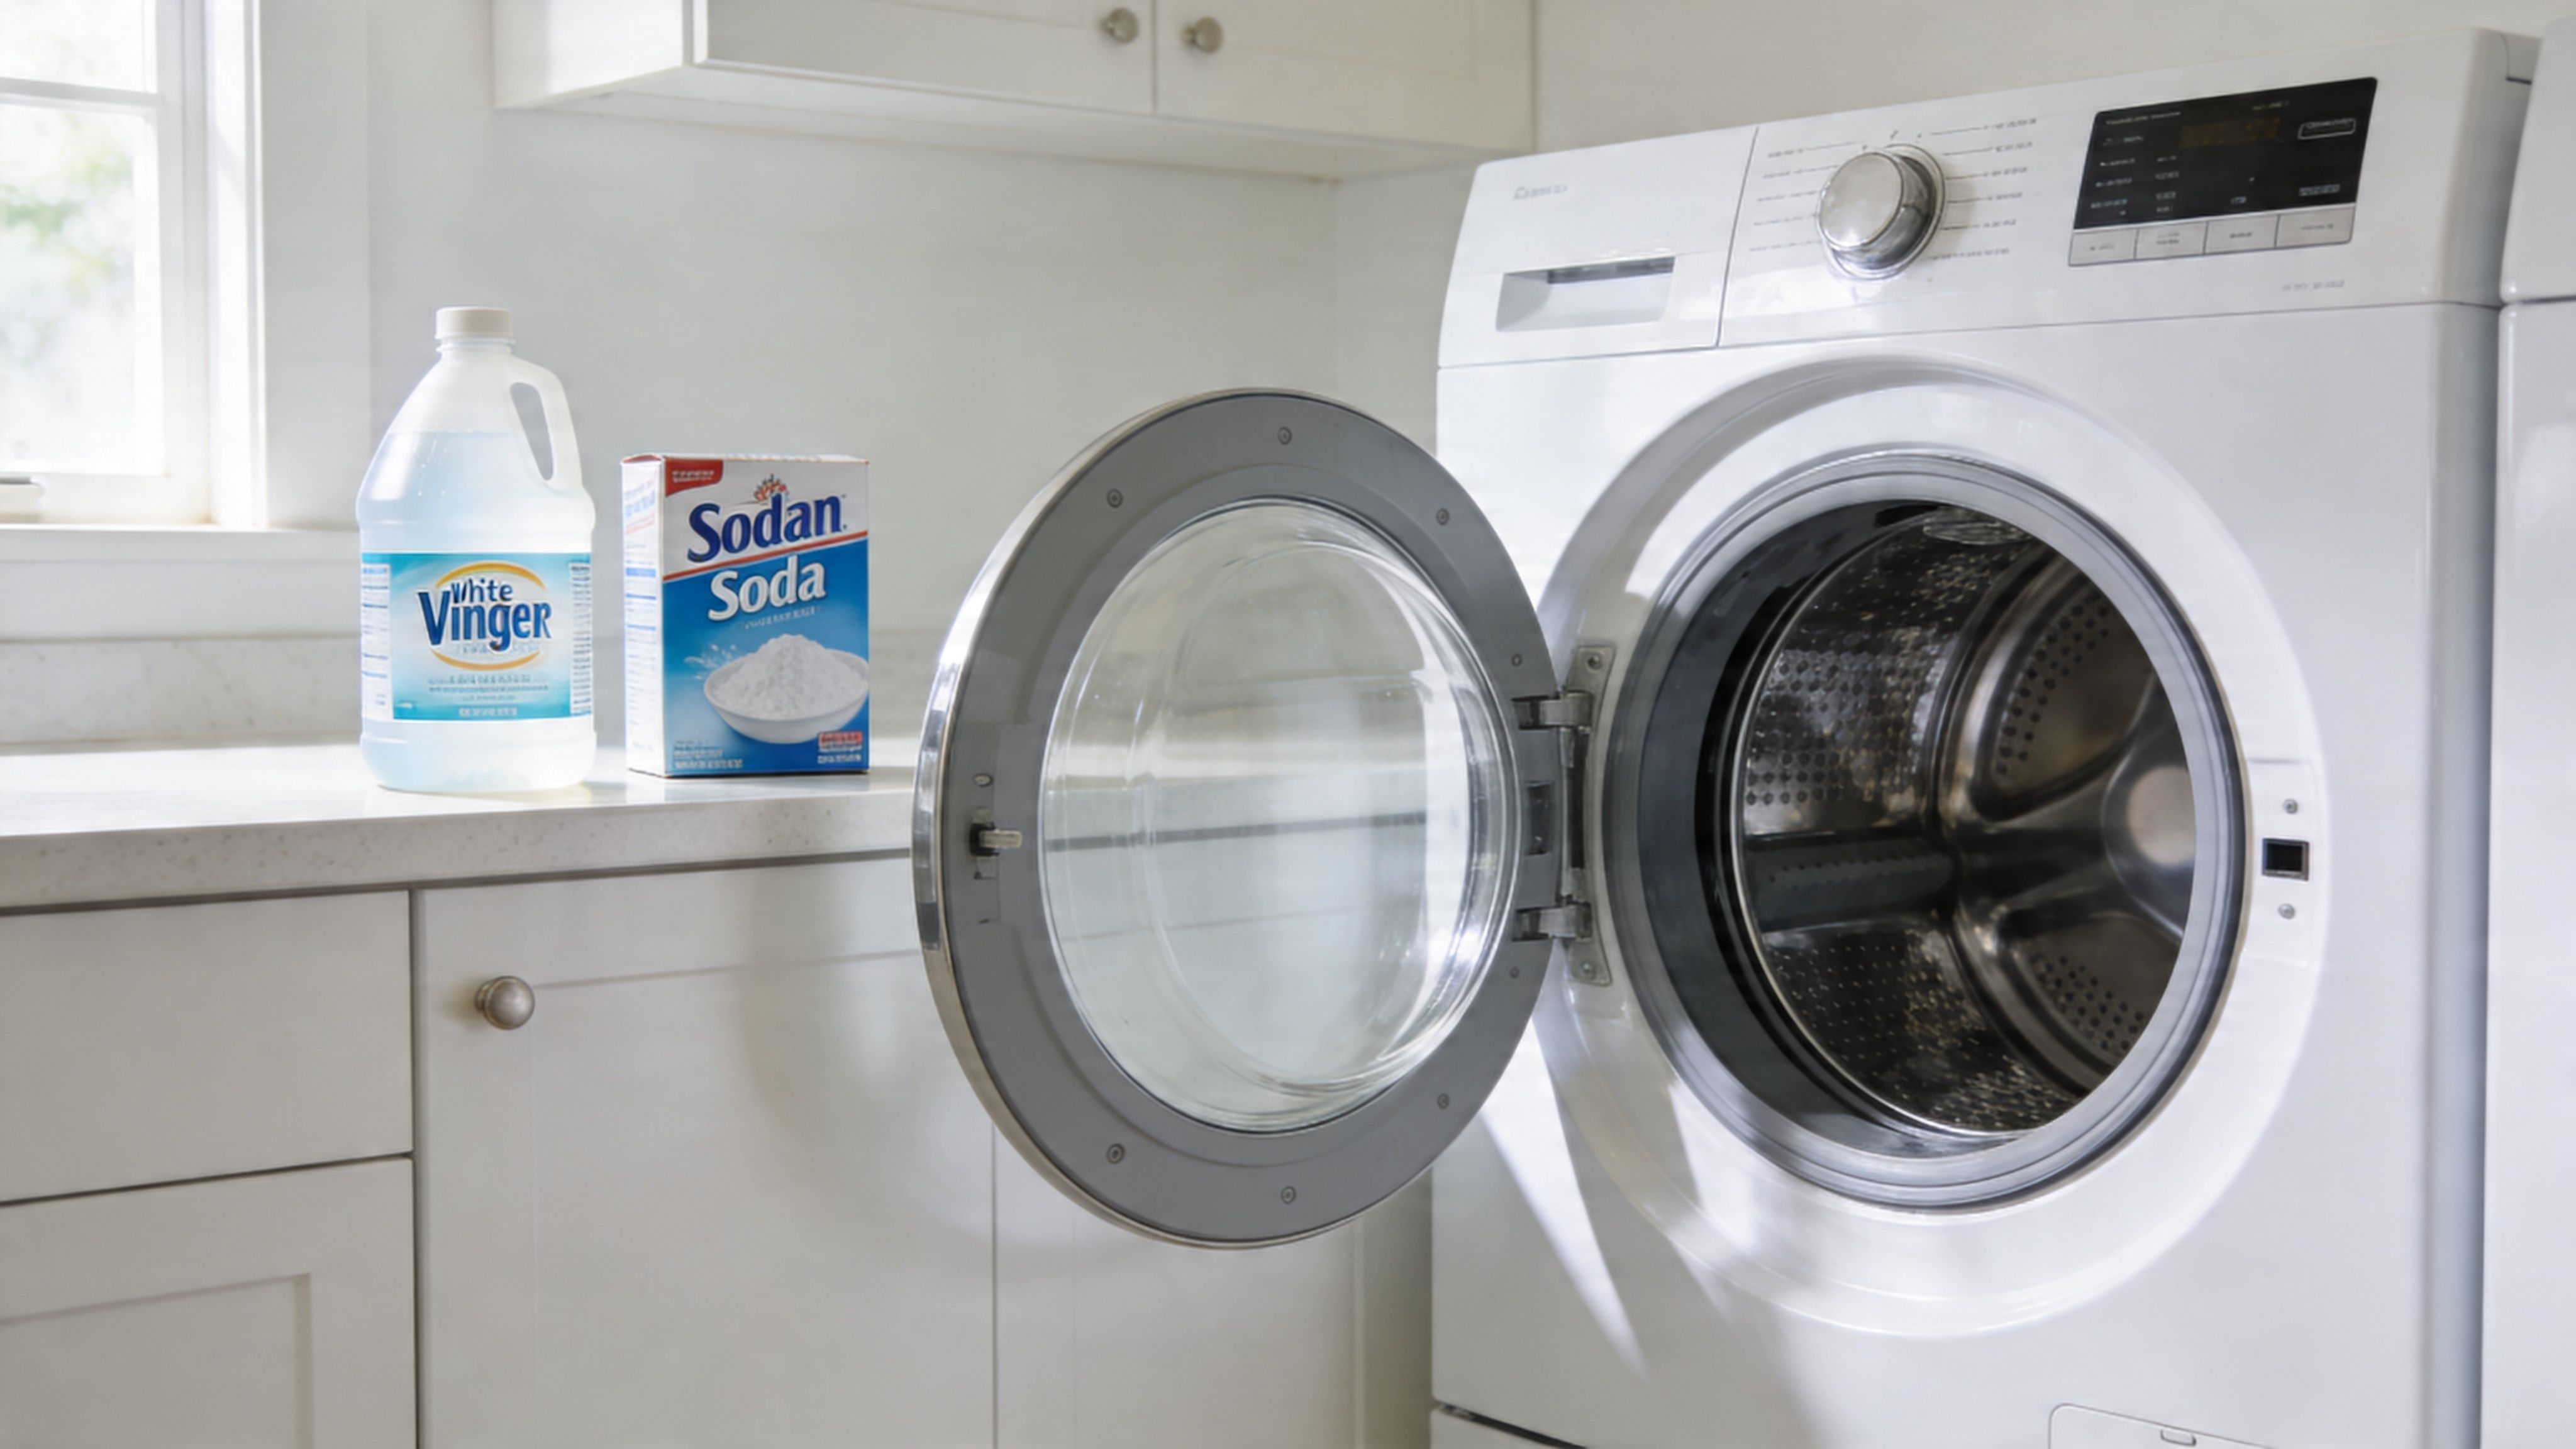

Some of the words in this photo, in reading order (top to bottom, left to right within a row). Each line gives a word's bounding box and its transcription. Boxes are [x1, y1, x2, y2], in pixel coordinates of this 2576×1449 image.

[687, 494, 841, 562] Sodan
[450, 578, 513, 603] White
[708, 555, 826, 621] Soda
